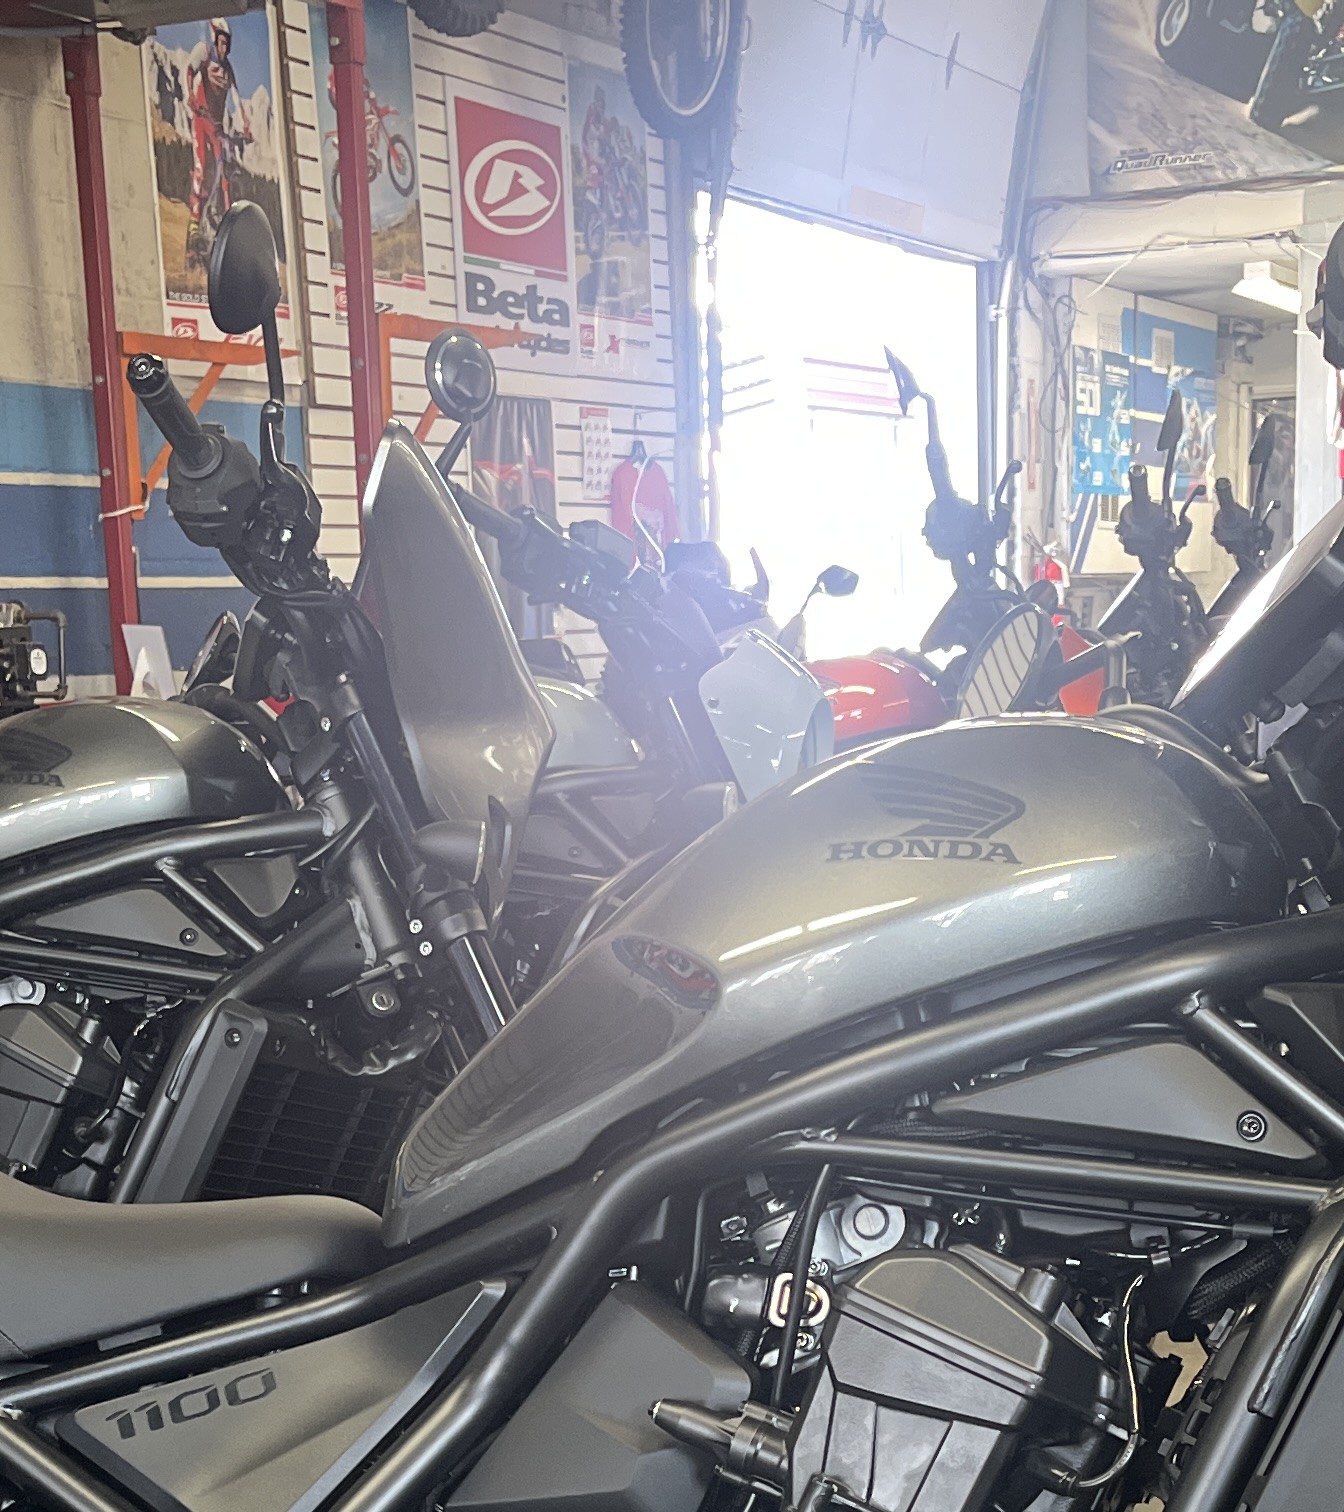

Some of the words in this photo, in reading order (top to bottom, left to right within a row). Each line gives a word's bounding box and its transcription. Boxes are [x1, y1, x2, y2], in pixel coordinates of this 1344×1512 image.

[464, 272, 570, 327] Beta
[826, 839, 1022, 864] HONDA
[106, 1367, 277, 1440] 1100
